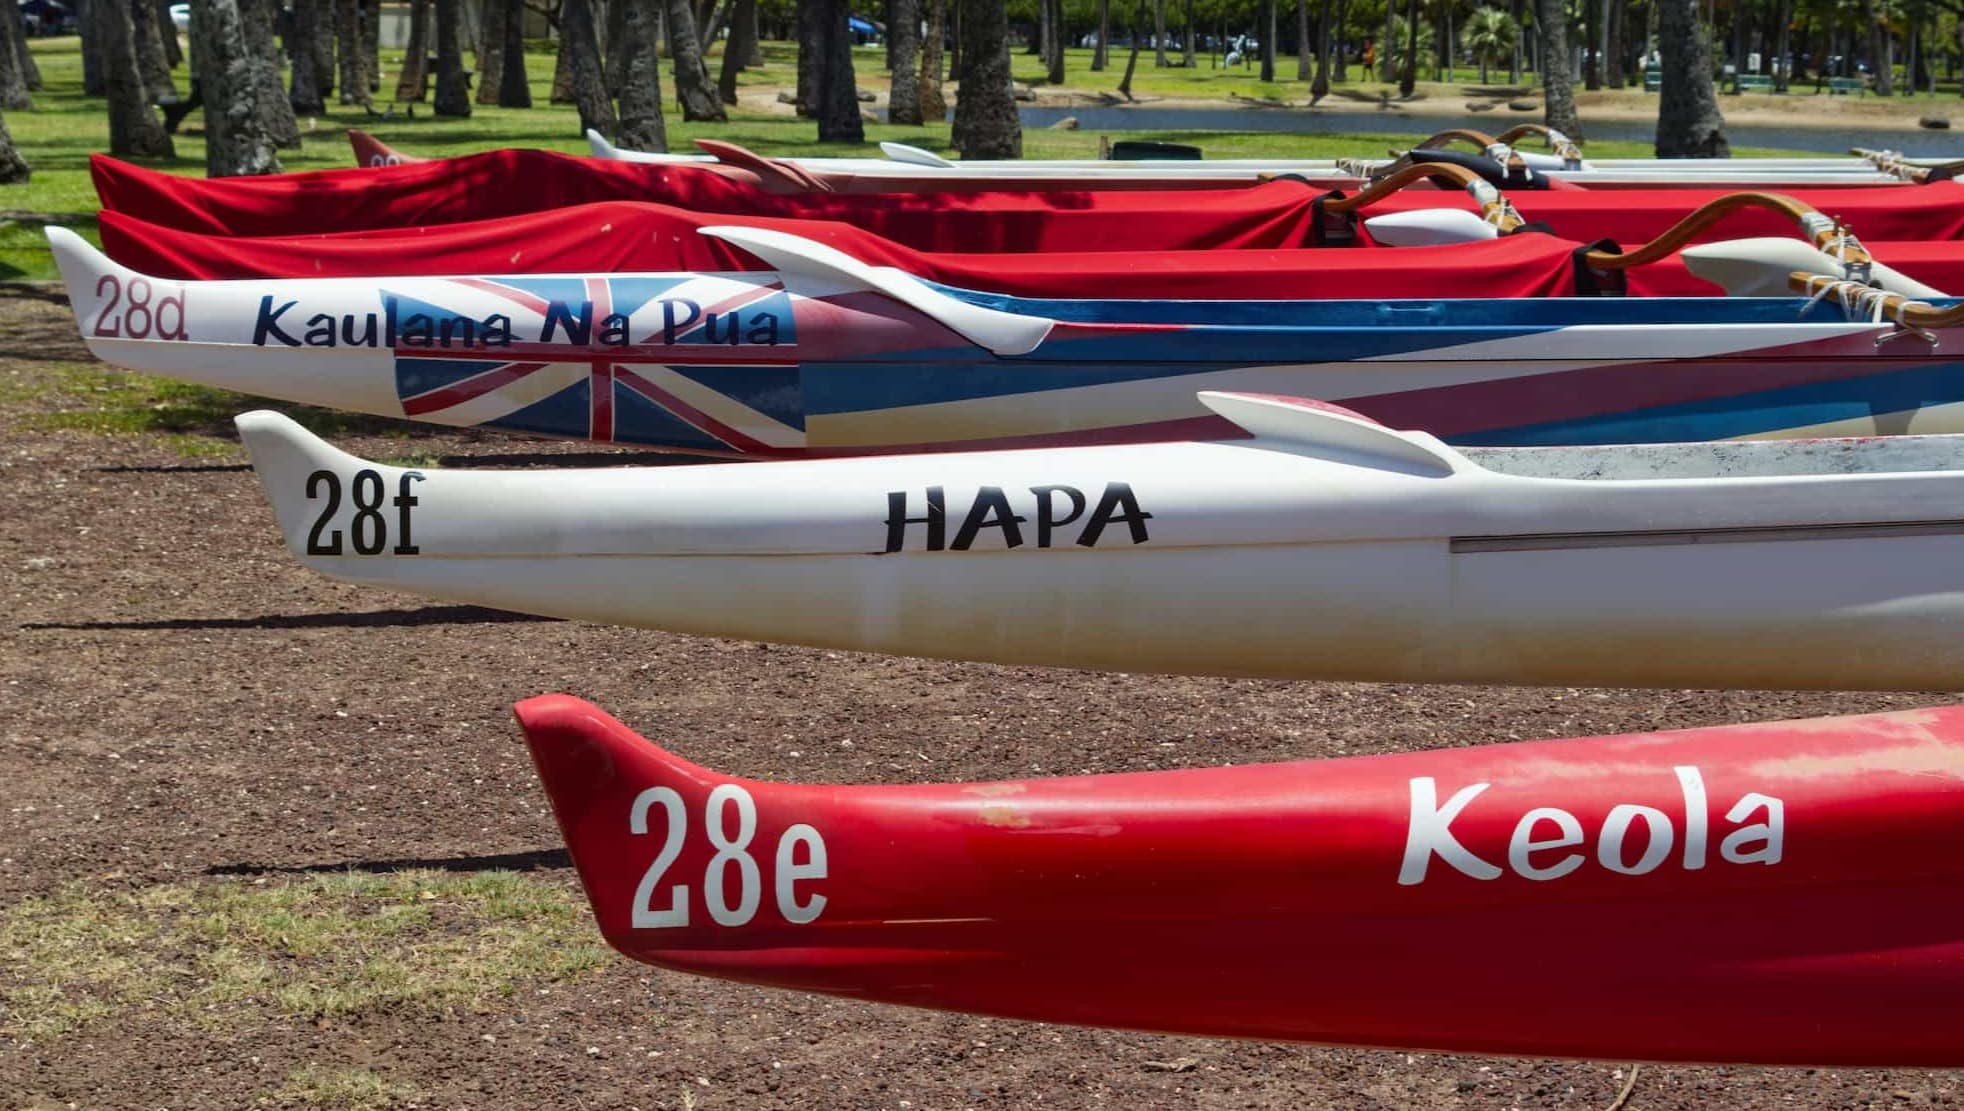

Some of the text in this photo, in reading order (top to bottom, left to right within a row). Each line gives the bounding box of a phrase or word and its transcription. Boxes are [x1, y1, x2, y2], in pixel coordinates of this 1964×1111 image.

[94, 274, 189, 341] 28d
[252, 294, 779, 348] Kaulana Na Pua
[305, 469, 426, 556] 28f
[883, 481, 1154, 552] HAPA
[630, 783, 828, 929] 28e
[1397, 765, 1785, 886] Keola
